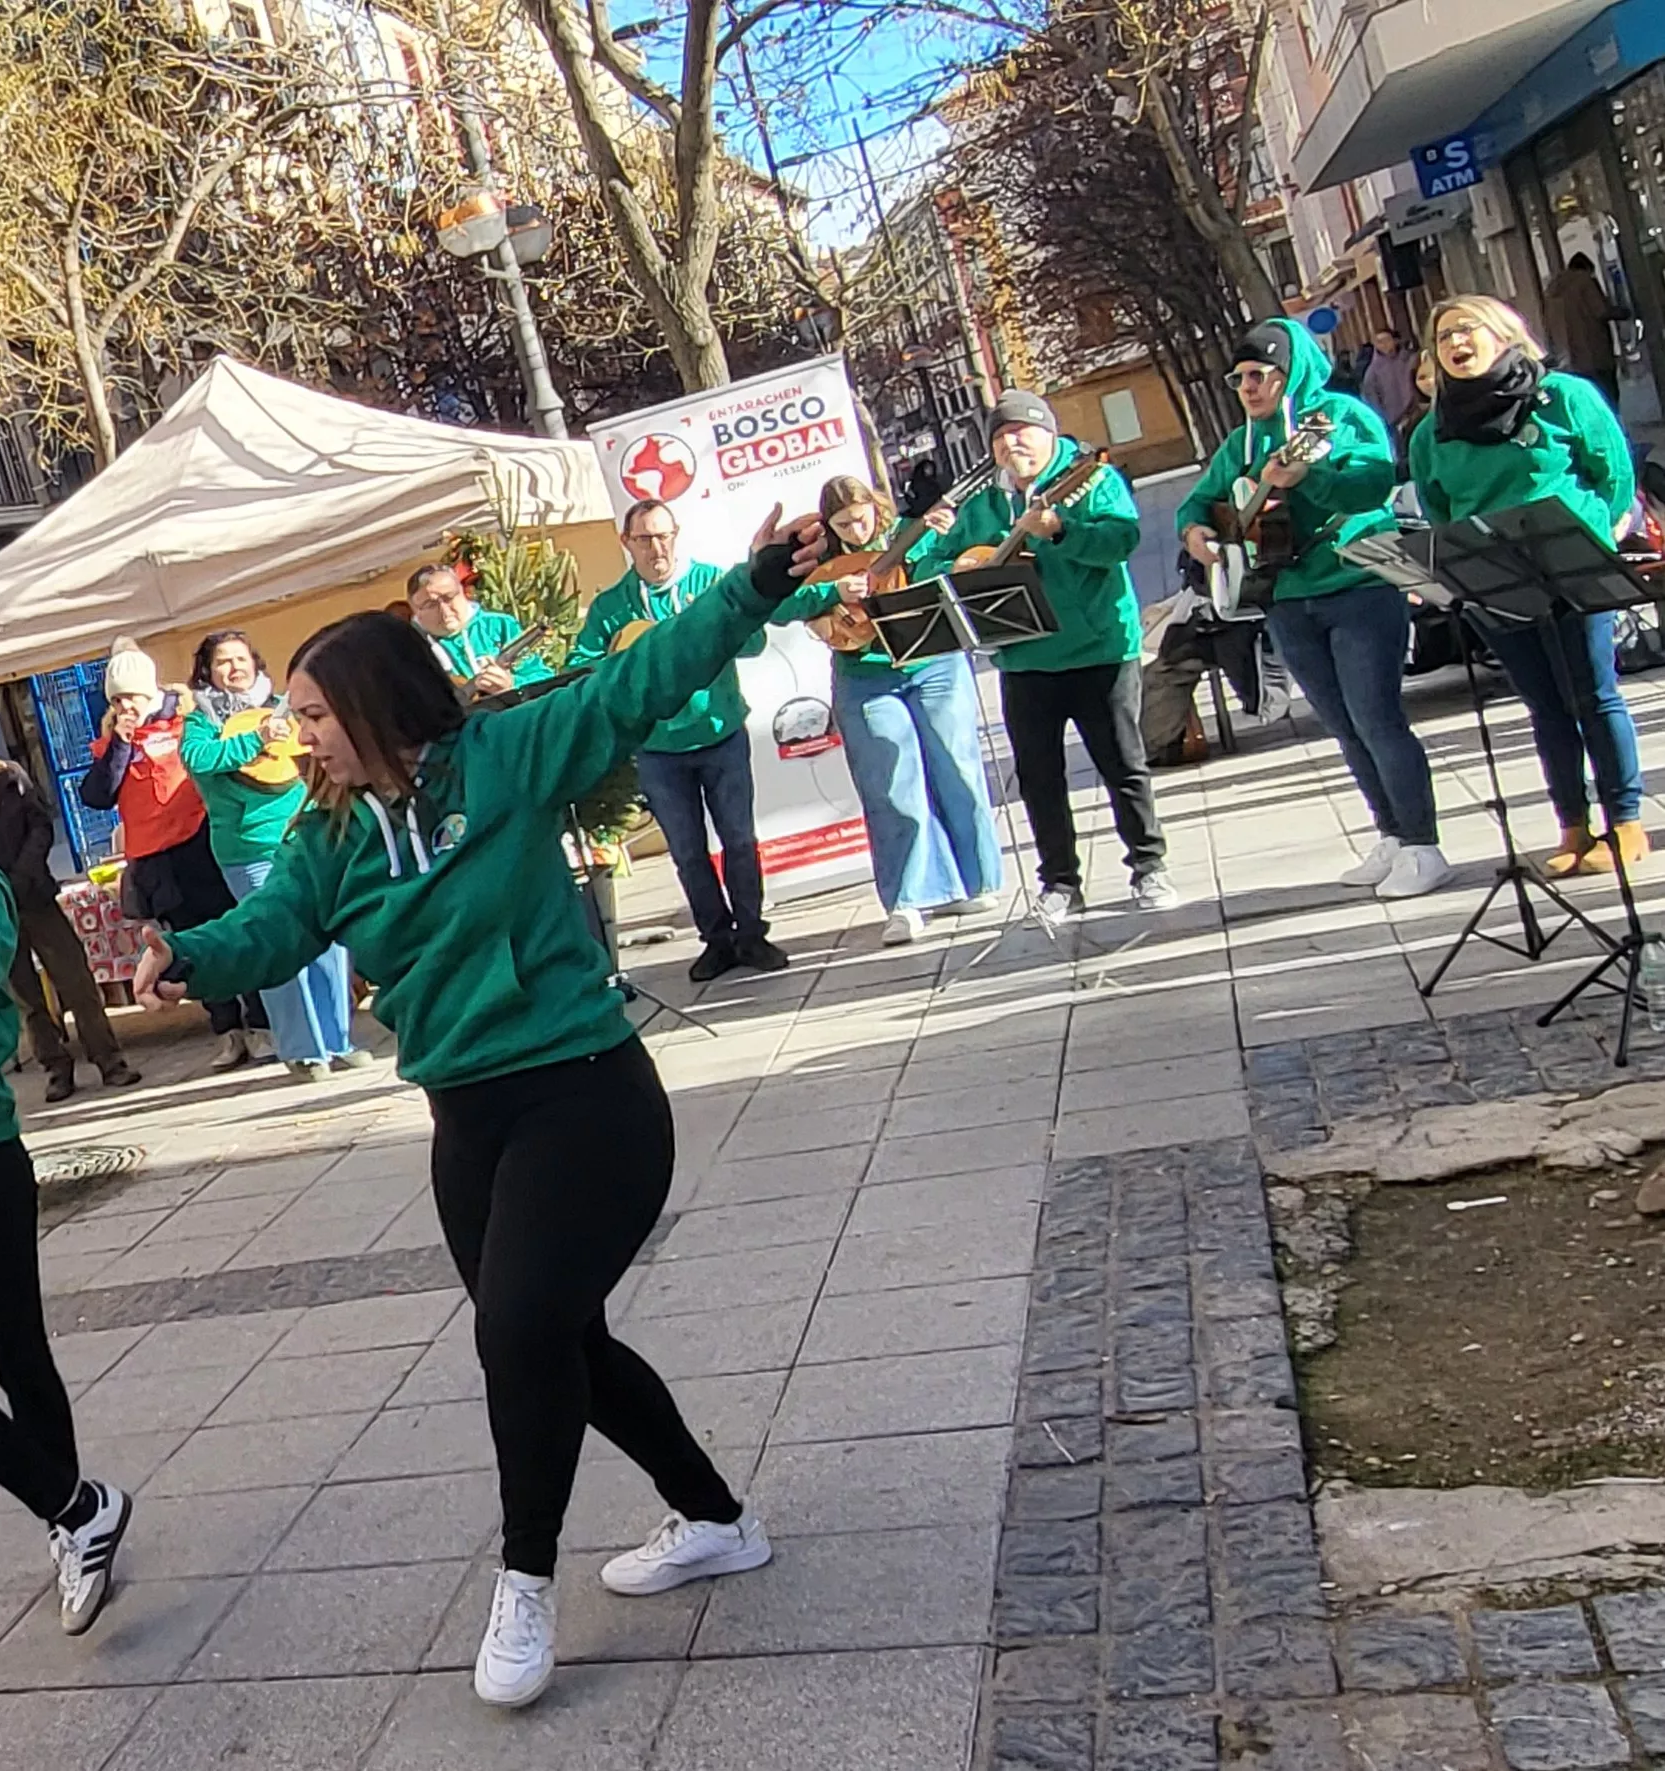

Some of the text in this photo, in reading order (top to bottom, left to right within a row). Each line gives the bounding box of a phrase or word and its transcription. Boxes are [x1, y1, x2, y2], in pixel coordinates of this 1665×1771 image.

[1444, 140, 1470, 168] S
[1431, 168, 1475, 195] ATM
[712, 396, 825, 448] BOSCO
[720, 420, 846, 476] GLOBAL
